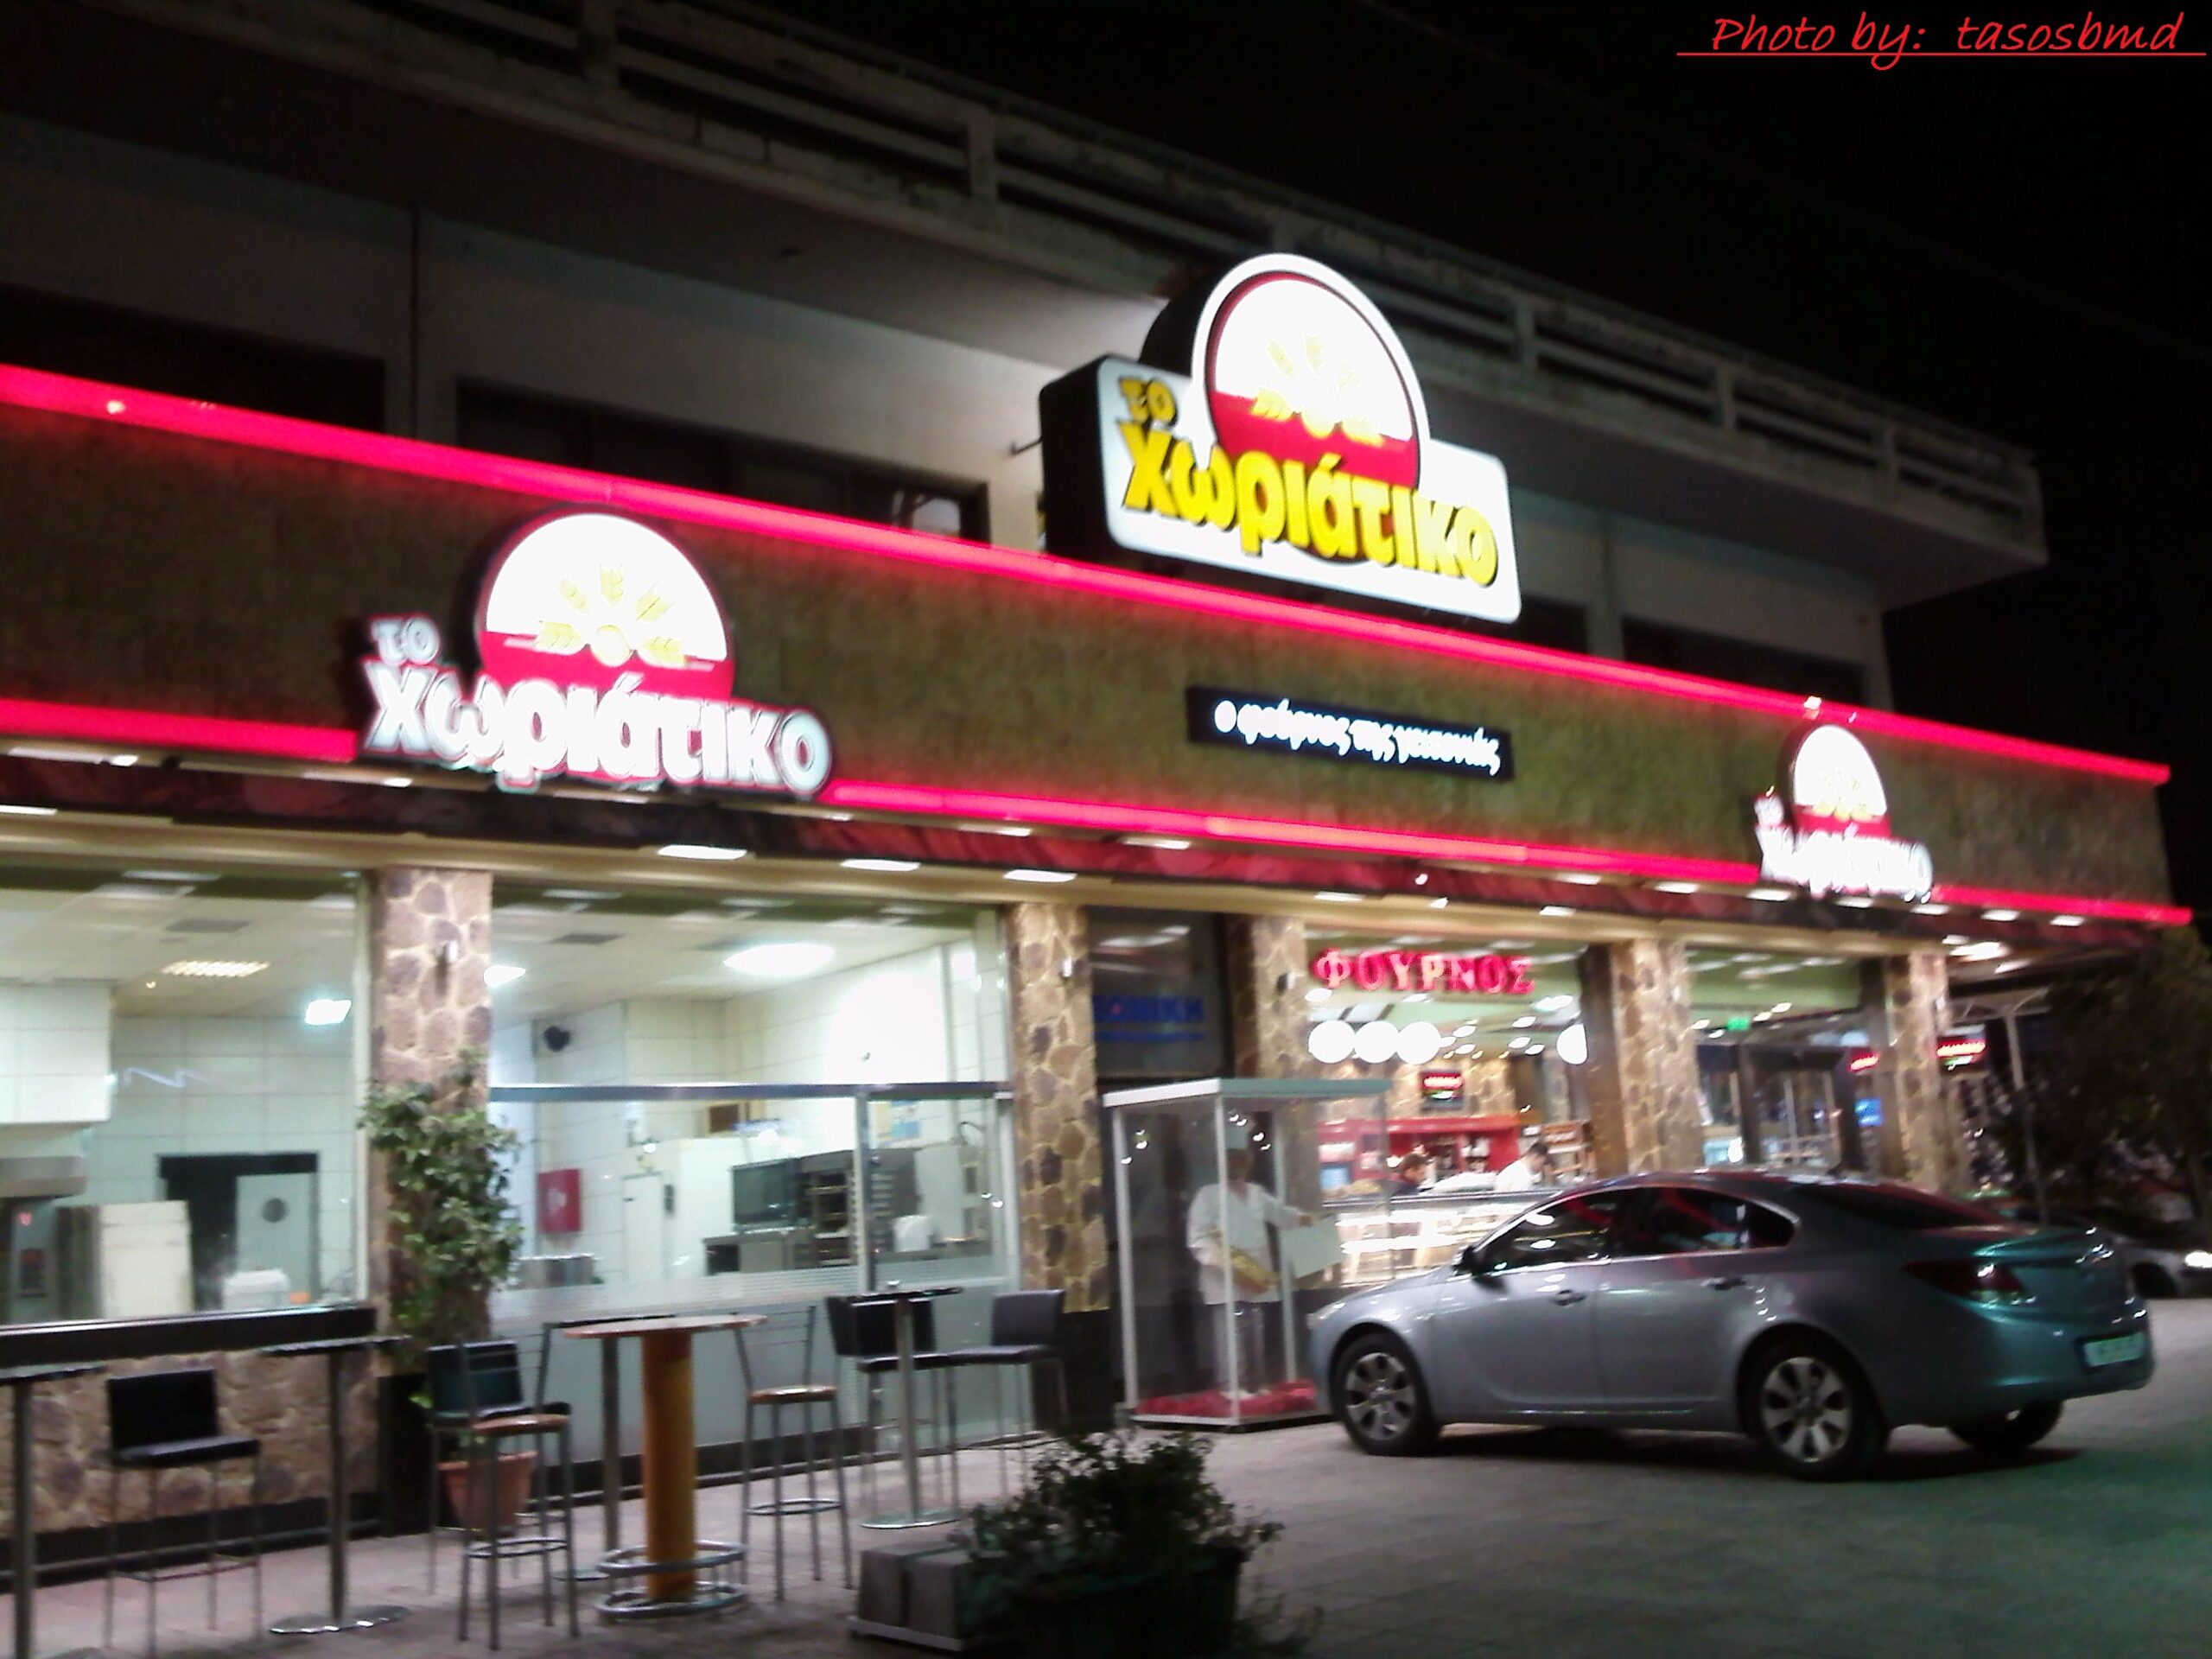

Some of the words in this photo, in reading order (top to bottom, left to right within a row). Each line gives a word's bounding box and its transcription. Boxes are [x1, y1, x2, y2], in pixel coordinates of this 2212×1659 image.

[1117, 421, 1498, 587] Χωριάτικο
[363, 657, 833, 794] Χωριάτικο
[1312, 947, 1535, 995] ΦΟΥΡΝΟΣ
